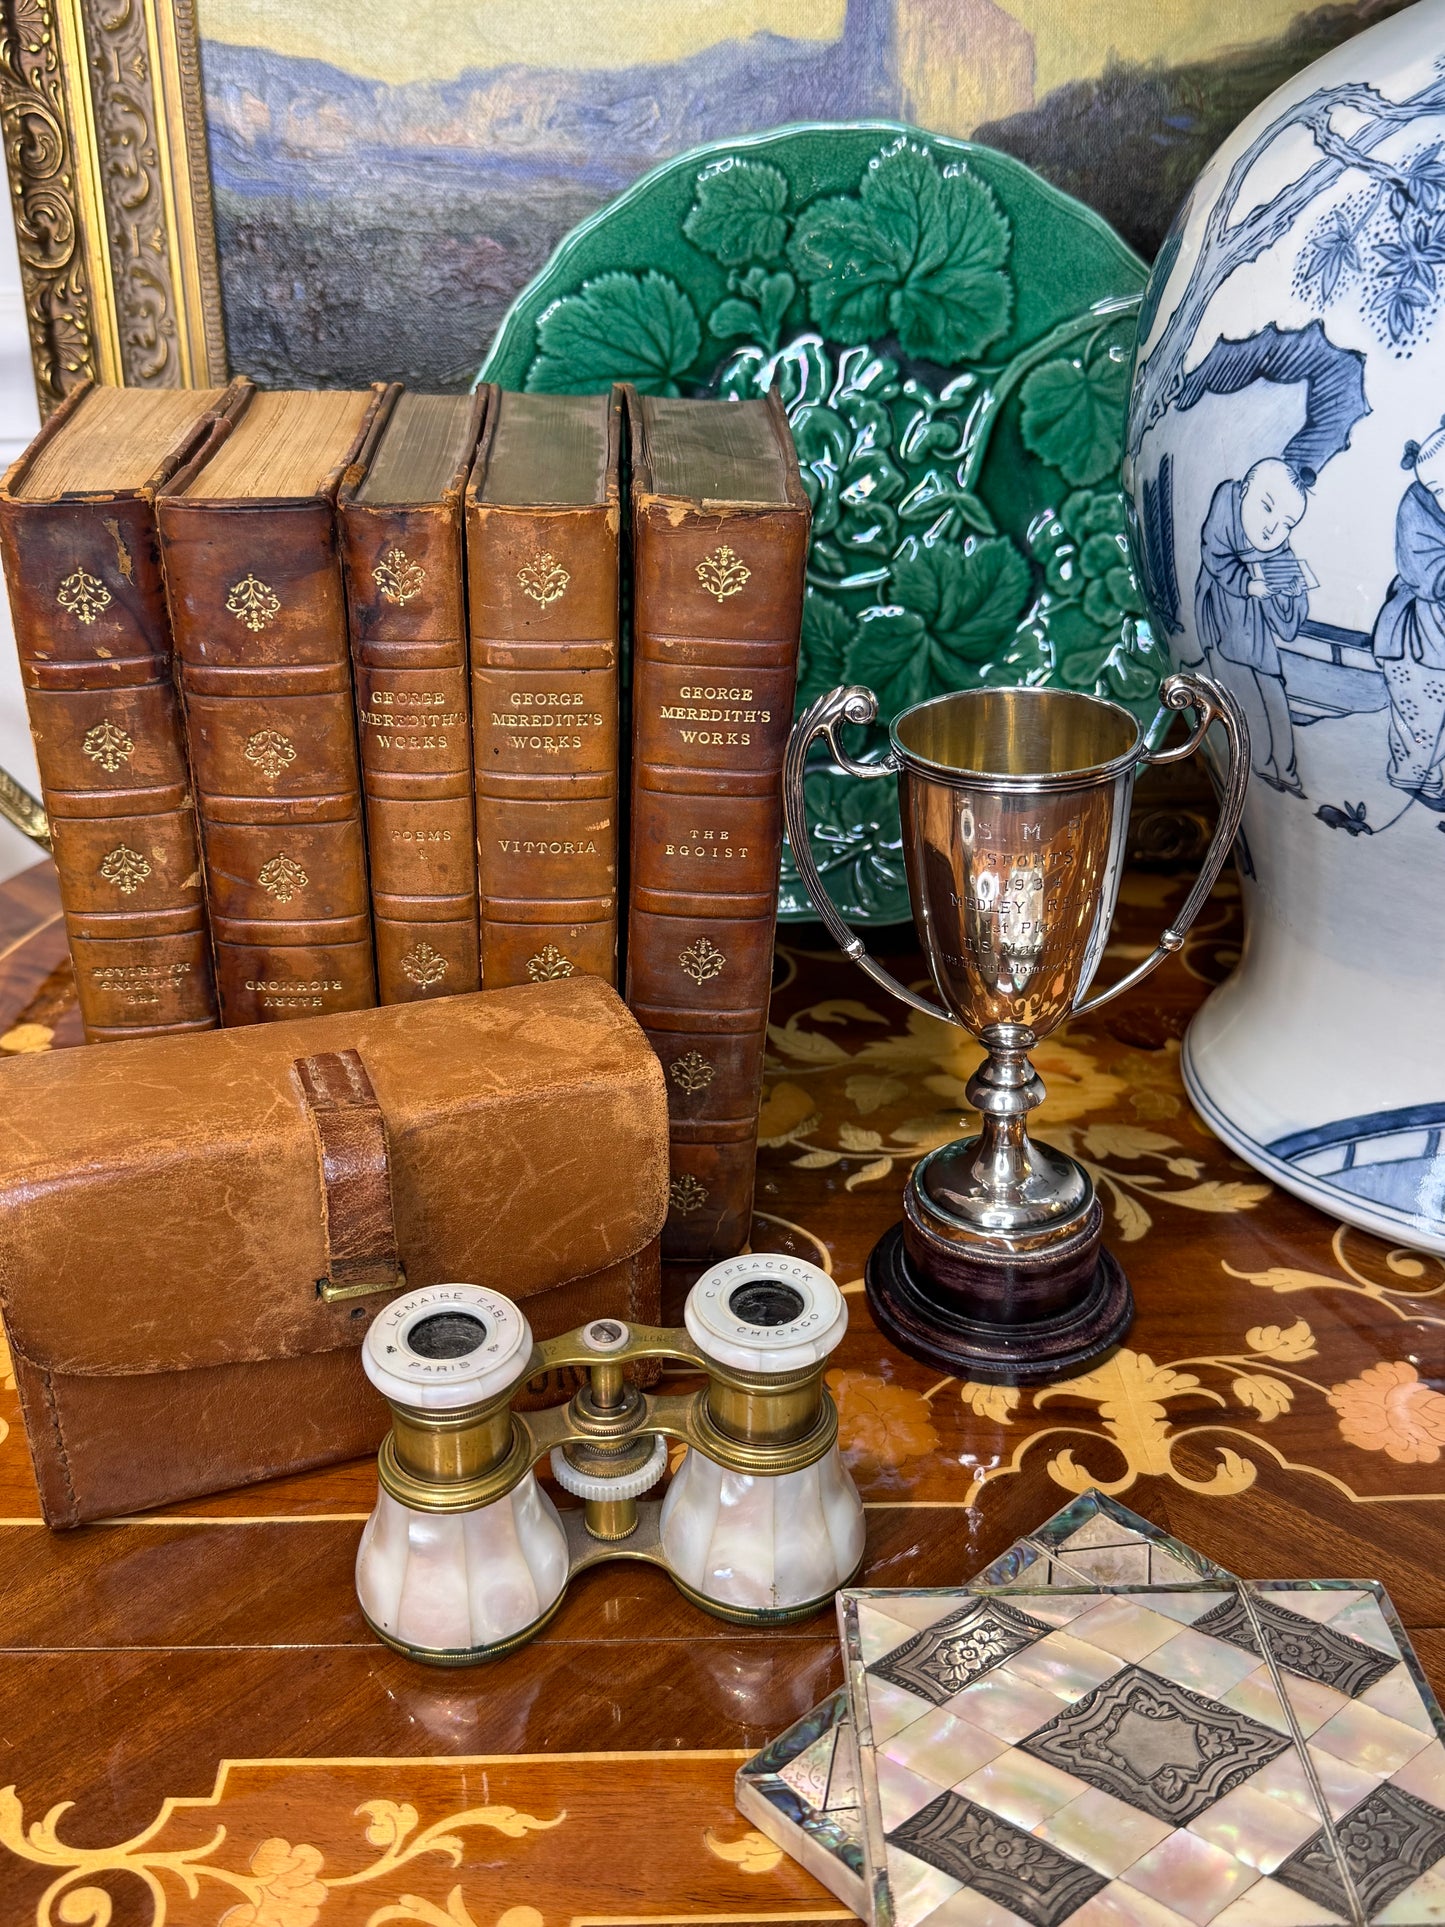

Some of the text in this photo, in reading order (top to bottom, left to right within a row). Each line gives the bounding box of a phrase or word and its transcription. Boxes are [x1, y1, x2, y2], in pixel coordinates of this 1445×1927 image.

[371, 691, 445, 706] GEORGE
[510, 692, 584, 706] GEORGE
[680, 687, 753, 701] GEORGE
[360, 710, 467, 728] MEREDITH'S
[491, 712, 603, 727] MEREDITH'S
[660, 706, 771, 723] MEREDITH'S
[376, 735, 448, 750] WORKS
[511, 735, 582, 749] WORKS
[679, 730, 751, 745] WORKS
[391, 829, 453, 842] POEMS
[689, 830, 729, 840] THE
[497, 839, 597, 855] VITTORIA
[665, 844, 749, 858] EGOIST
[986, 849, 1074, 868] SPORTS
[950, 892, 1026, 914] MEDLEY
[244, 979, 343, 992] RICHMOND
[263, 995, 323, 1007] HARRY
[386, 1291, 464, 1327] LEMAIRE
[736, 1312, 820, 1337] CHICAGO
[408, 1361, 472, 1373] PARIS
